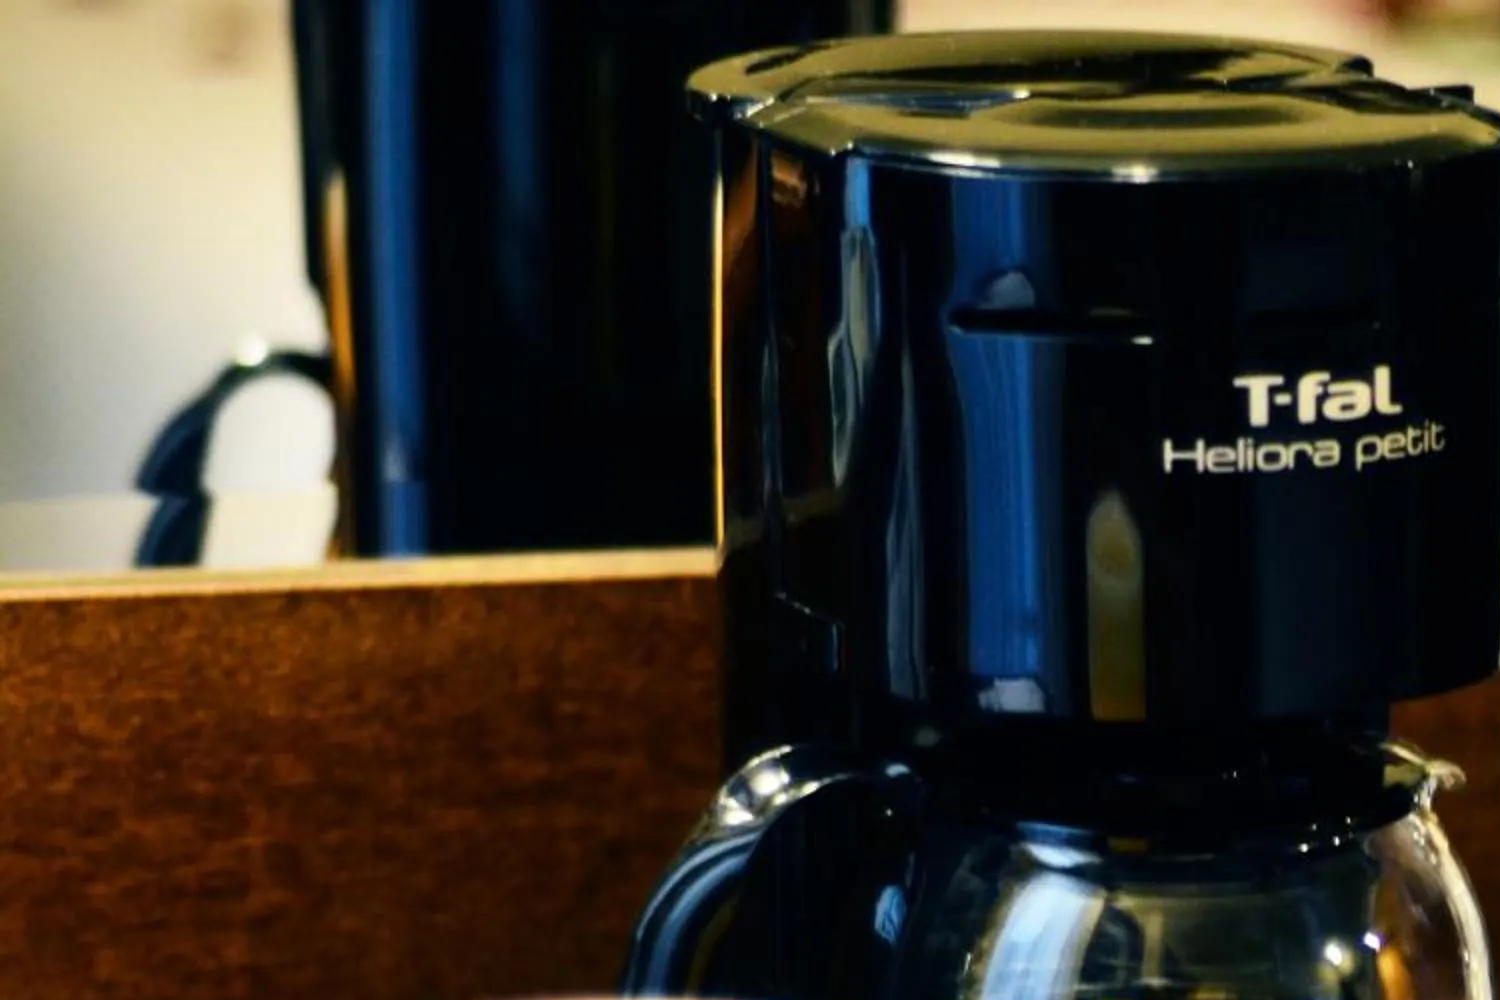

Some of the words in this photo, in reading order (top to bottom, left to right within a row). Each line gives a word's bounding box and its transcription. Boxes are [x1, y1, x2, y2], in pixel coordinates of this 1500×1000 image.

[1232, 364, 1403, 427] T-fal
[1162, 436, 1341, 474] Heliora
[1355, 418, 1446, 473] petit
